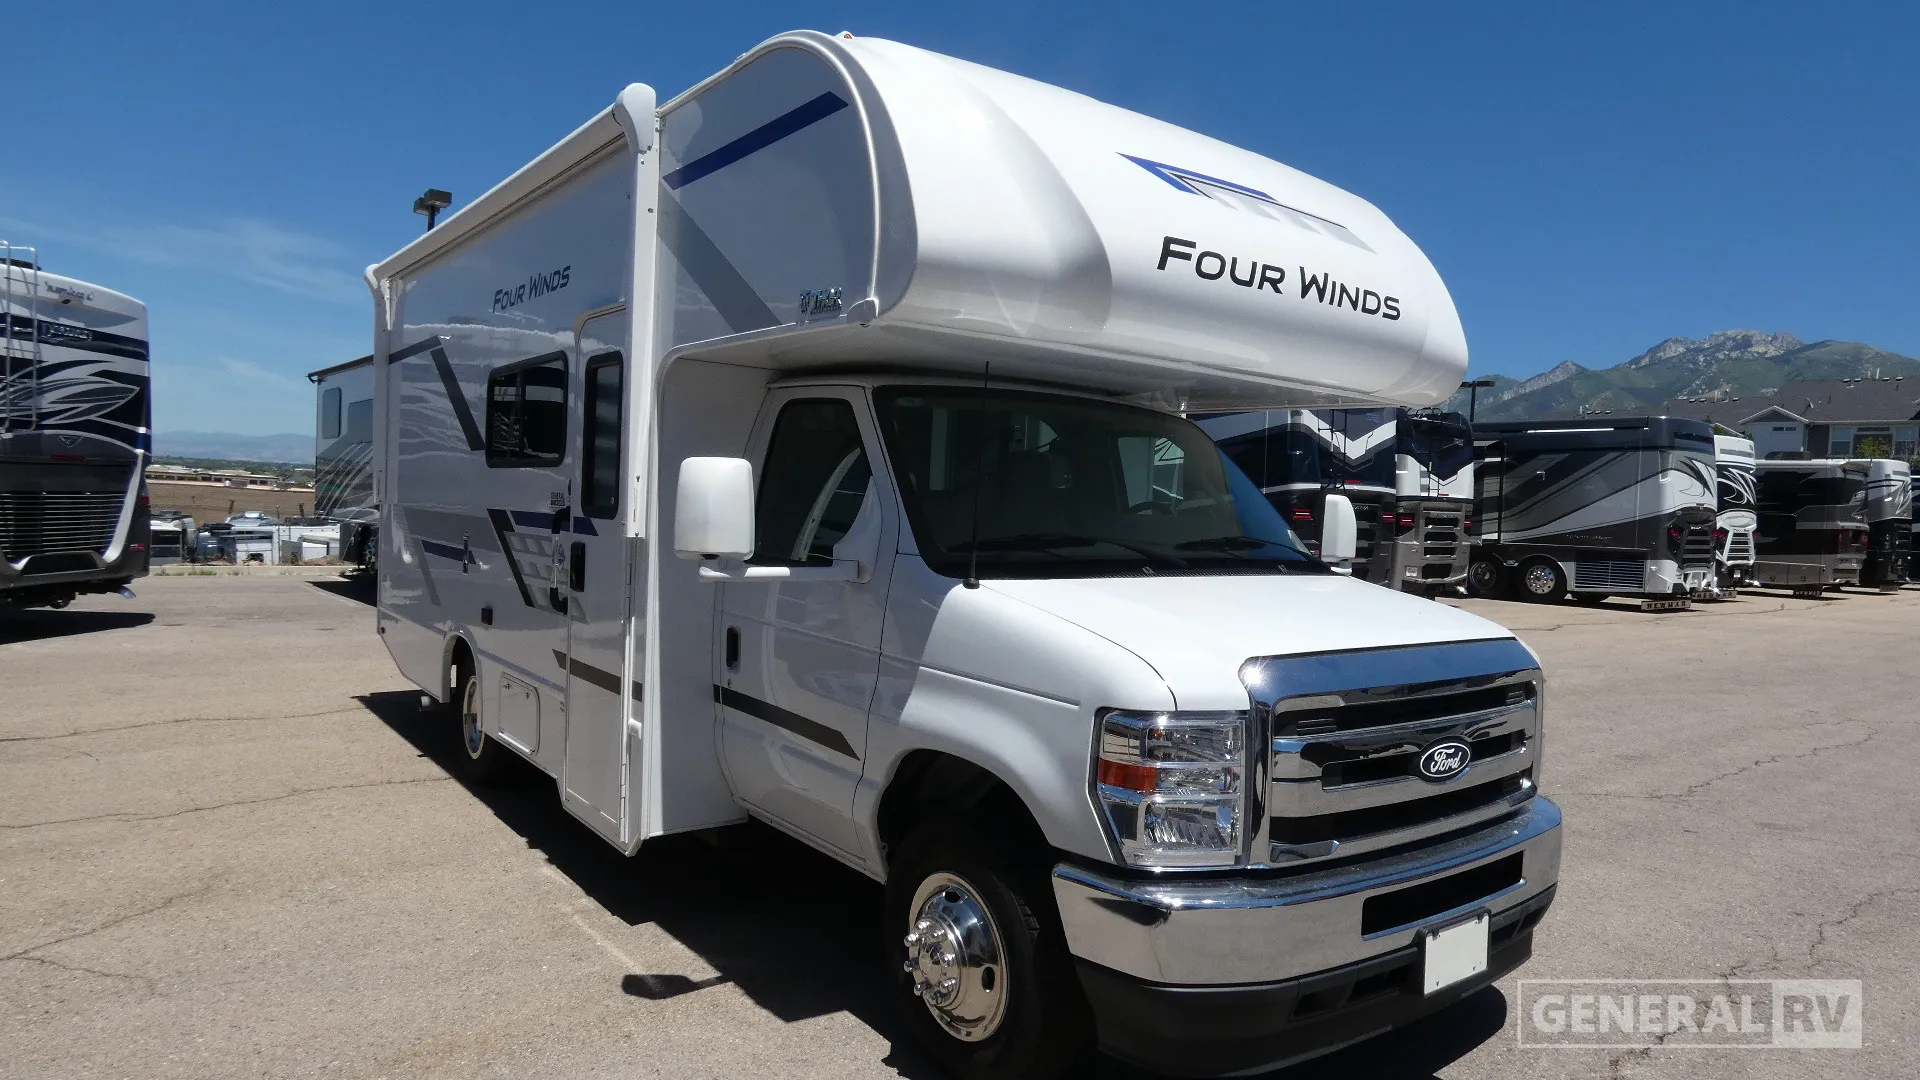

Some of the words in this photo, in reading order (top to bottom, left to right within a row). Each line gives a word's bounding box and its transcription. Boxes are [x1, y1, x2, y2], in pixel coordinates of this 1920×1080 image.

[493, 284, 525, 313] FOUR
[528, 265, 571, 300] WINDS
[1157, 236, 1286, 295] FOUR
[1299, 266, 1401, 321] WINDS
[1647, 601, 1686, 609] NEWMAR
[1430, 748, 1462, 773] Ford
